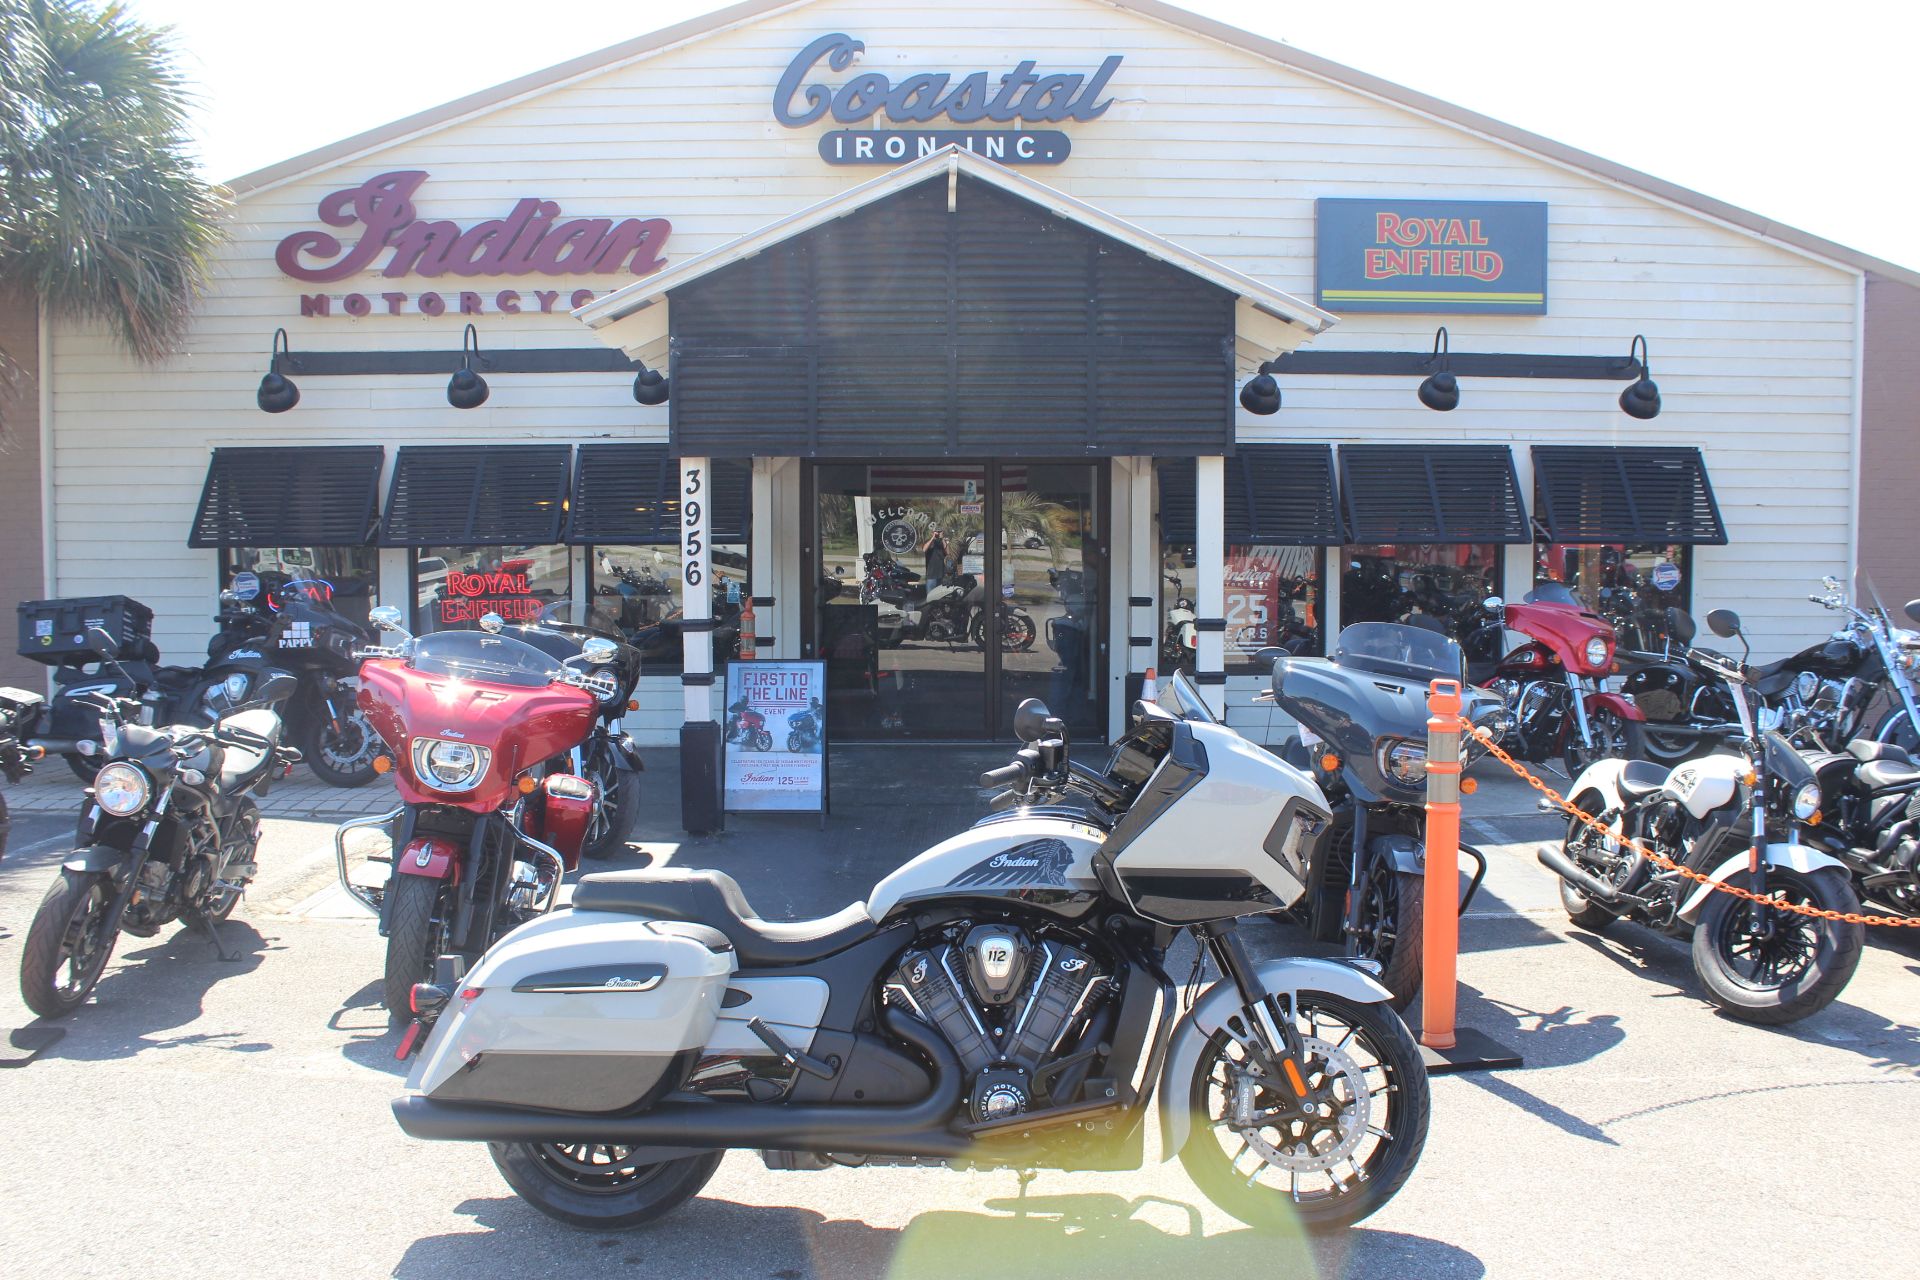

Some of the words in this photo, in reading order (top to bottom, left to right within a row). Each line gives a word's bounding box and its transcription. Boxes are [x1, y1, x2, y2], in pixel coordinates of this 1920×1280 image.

[772, 33, 1124, 128] Coastal
[836, 136, 938, 158] IRON
[966, 136, 1054, 158] INC.
[275, 170, 673, 284] Indian
[1376, 212, 1488, 248] ROYAL
[1364, 249, 1504, 282] ENFIELD
[300, 289, 617, 317] MOTORCYC
[446, 571, 532, 597] ROYAL
[441, 598, 544, 623] ENFIELD
[1226, 594, 1268, 625] 25
[279, 638, 314, 649] PAPPY
[1224, 628, 1268, 639] EARS
[743, 672, 787, 686] FIRST
[790, 672, 808, 686] TO
[743, 687, 771, 700] THE
[775, 687, 808, 701] LINE
[740, 772, 774, 783] Indian
[778, 776, 794, 785] 125
[989, 854, 1039, 868] Indian
[988, 950, 1007, 962] 112
[605, 976, 641, 988] Indian
[981, 1089, 993, 1121] INDIAN
[993, 1083, 1027, 1112] MOTORCYC
[1241, 1087, 1249, 1117] brembo
